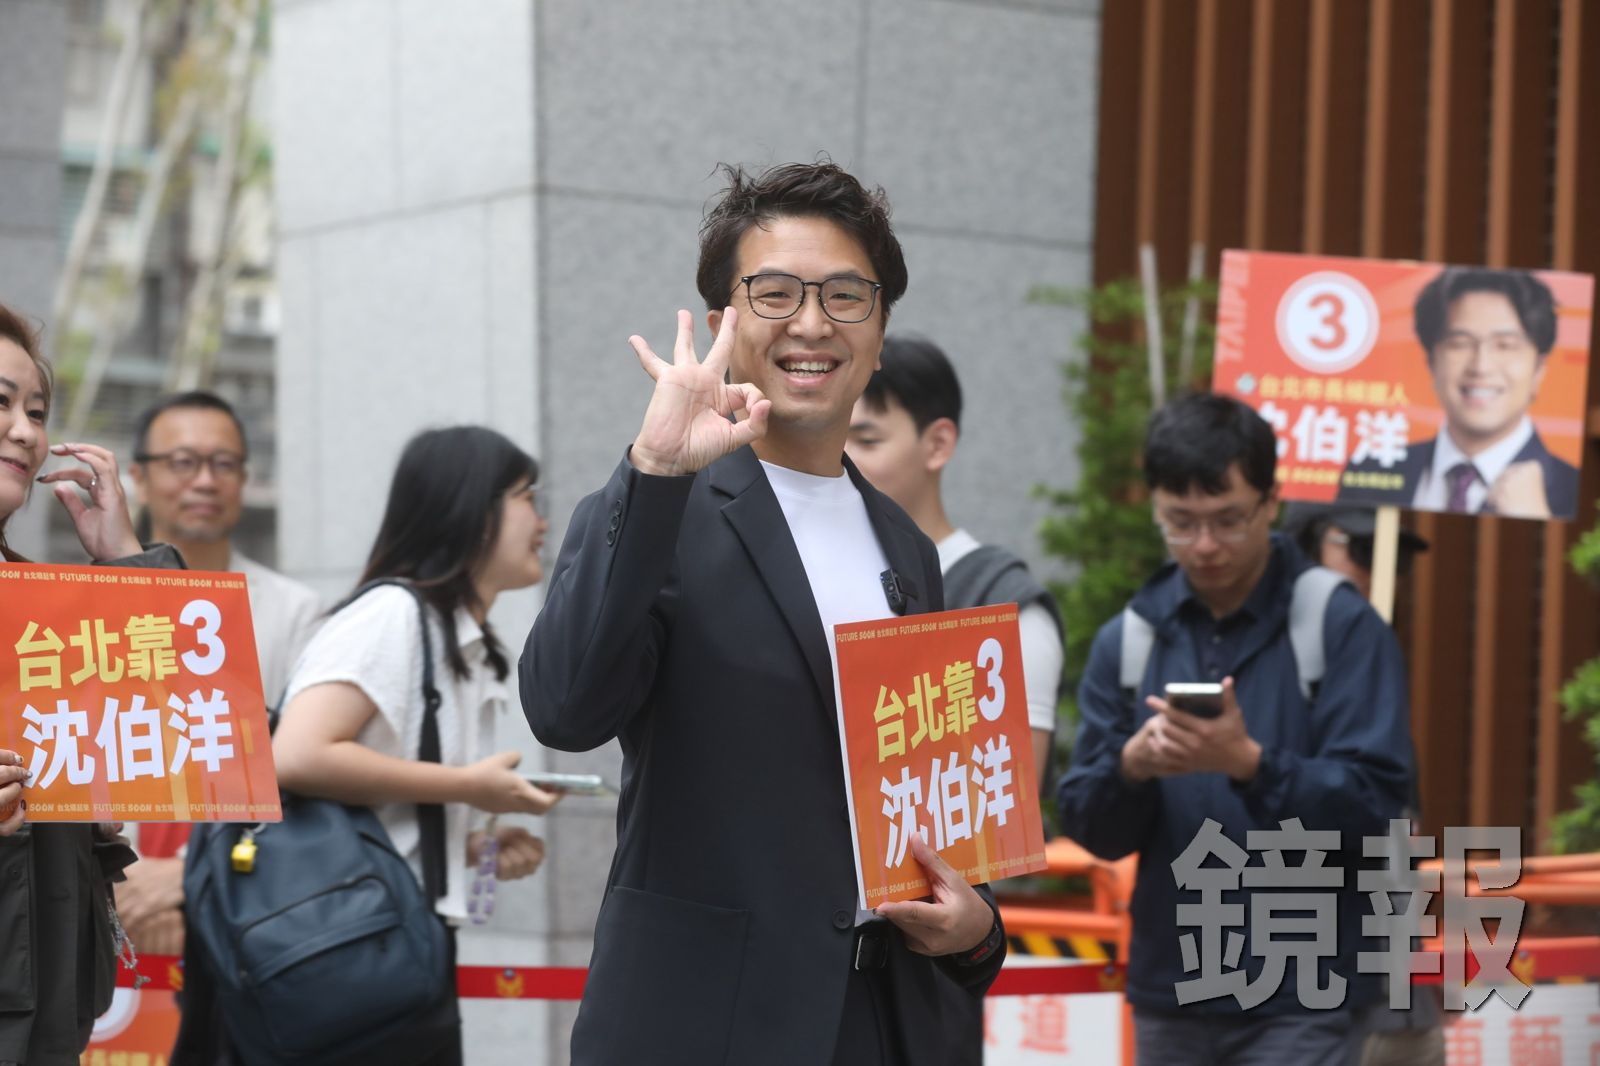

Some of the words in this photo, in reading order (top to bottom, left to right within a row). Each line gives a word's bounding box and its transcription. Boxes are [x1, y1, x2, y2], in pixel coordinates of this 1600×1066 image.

[1306, 293, 1348, 352] 3
[0, 571, 20, 579] OON
[60, 573, 92, 582] FUTURE
[94, 574, 118, 584] SOON
[156, 577, 187, 587] FUTURE
[189, 579, 212, 588] SOON
[14, 599, 226, 692] 台北靠3
[836, 632, 858, 643] FUTURE
[860, 630, 876, 640] SOON
[900, 624, 920, 636] FUTURE
[921, 622, 937, 632] SOON
[960, 616, 980, 627] FUTURE
[981, 614, 996, 625] SOON
[873, 637, 1006, 763] 台北靠3
[21, 688, 235, 790] 沈伯洋
[30, 803, 54, 812] SOON
[94, 803, 126, 812] FUTURE
[128, 803, 152, 812] SOON
[880, 733, 1015, 870] 沈伯洋
